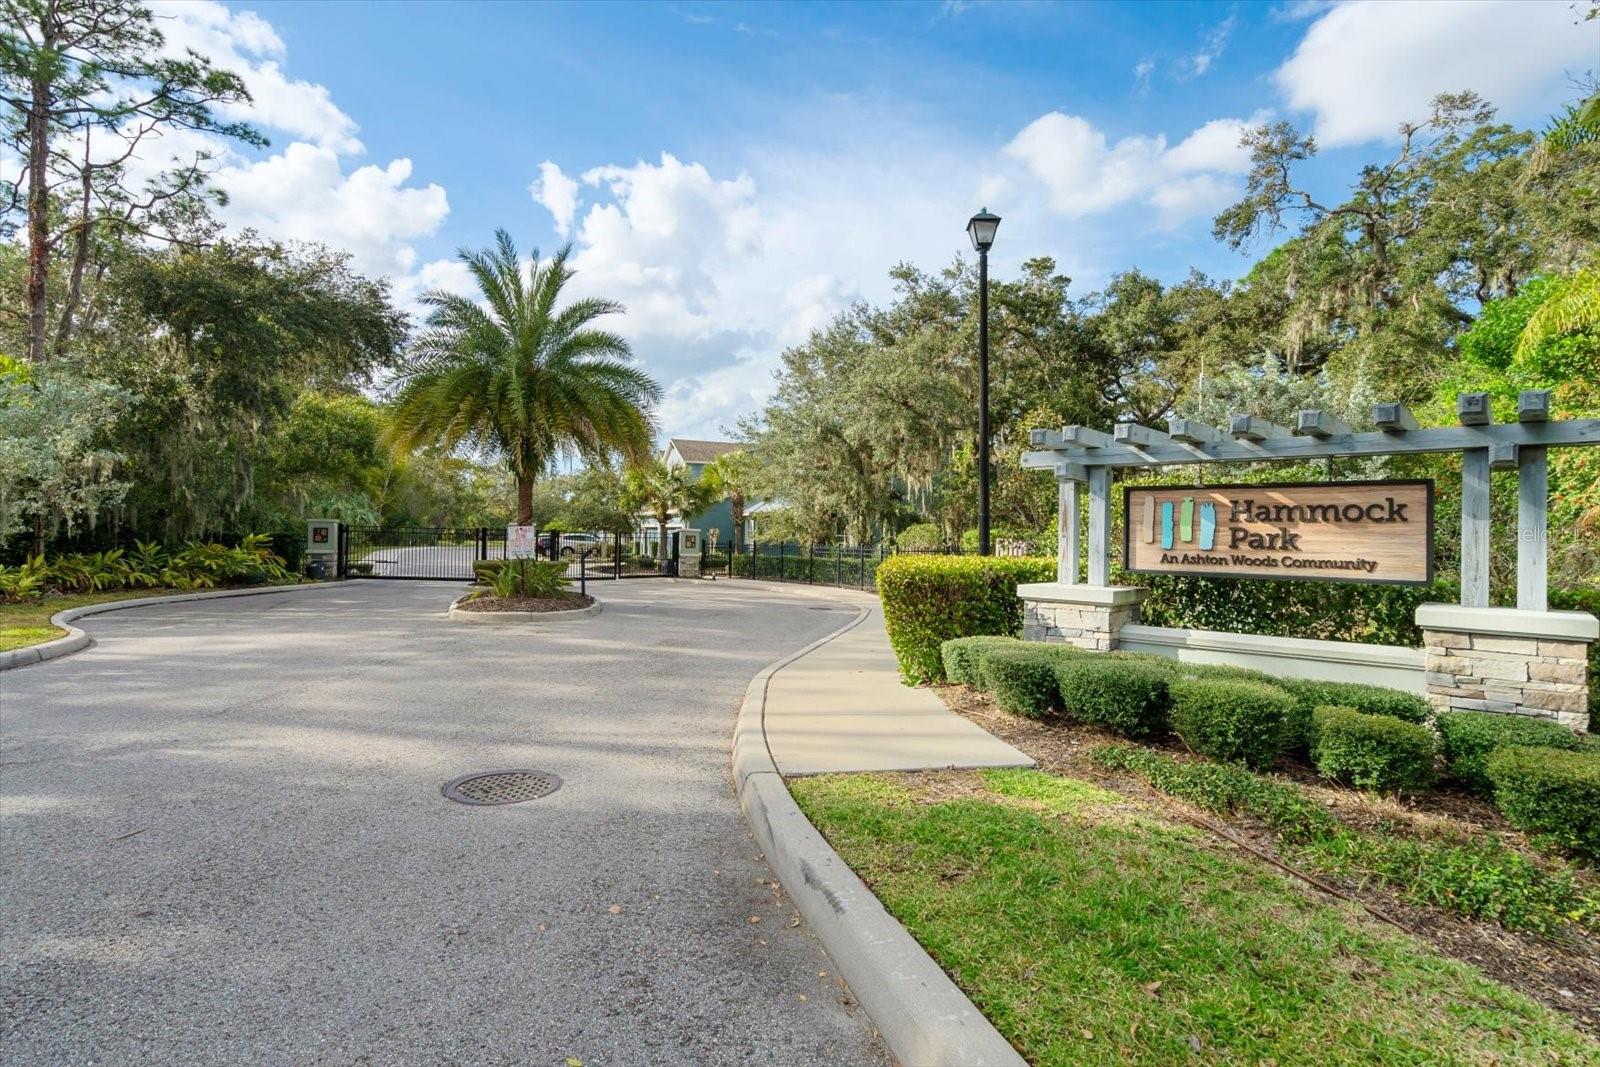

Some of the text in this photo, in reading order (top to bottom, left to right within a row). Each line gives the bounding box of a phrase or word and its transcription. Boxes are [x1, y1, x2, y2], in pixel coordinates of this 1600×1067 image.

[1229, 498, 1408, 522] Hammock
[1229, 527, 1301, 550] Park
[1160, 553, 1378, 573] An Ashton Woods Community
